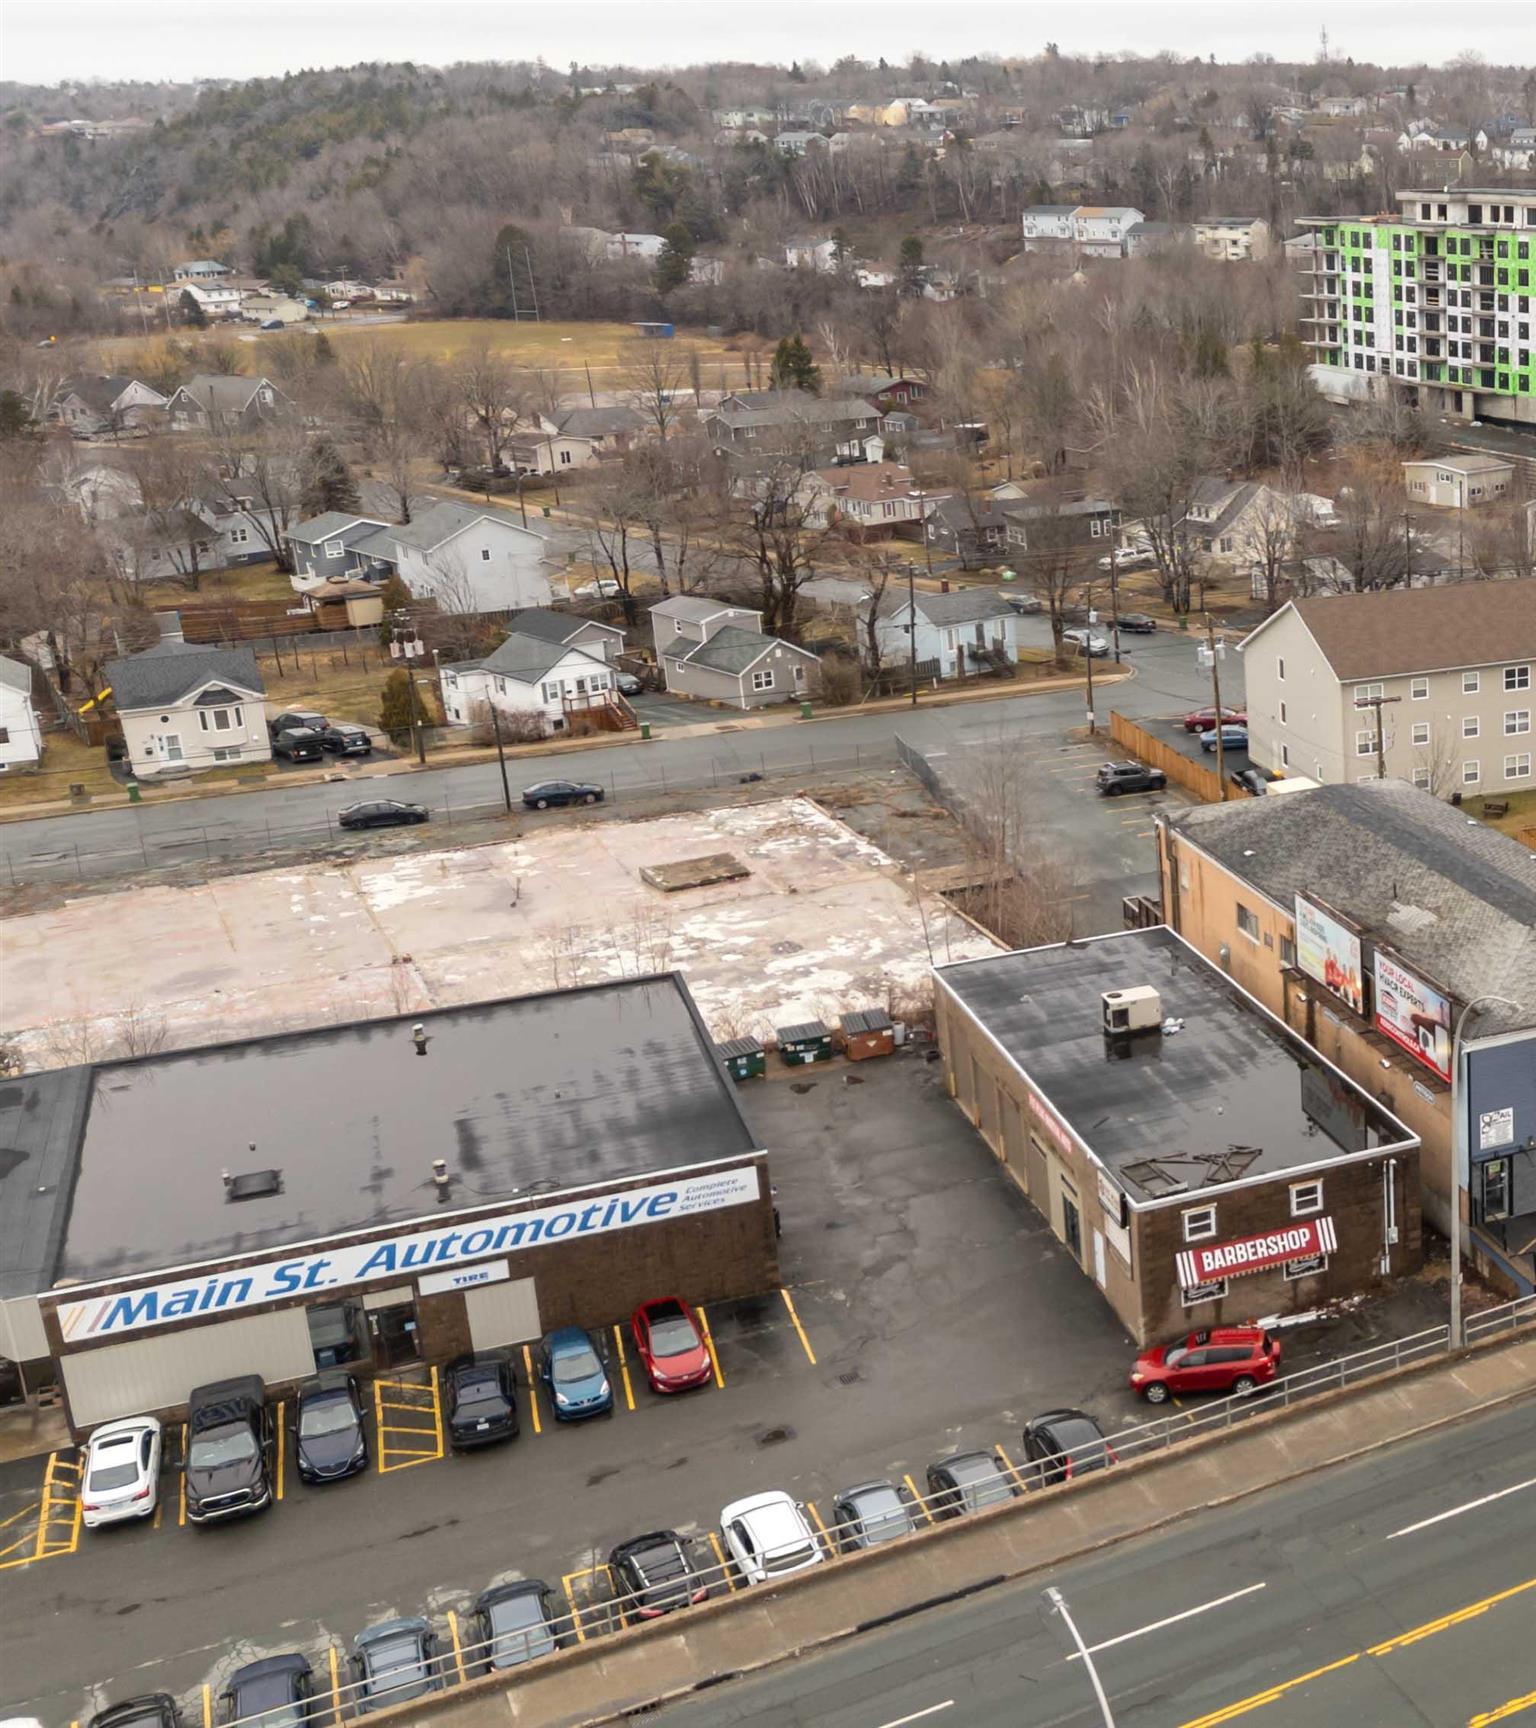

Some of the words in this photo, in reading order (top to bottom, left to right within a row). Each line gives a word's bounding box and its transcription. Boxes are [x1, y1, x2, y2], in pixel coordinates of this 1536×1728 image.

[682, 1184, 748, 1202] Automotive
[685, 1178, 739, 1194] Complete
[678, 1197, 726, 1211] Services
[1201, 1227, 1312, 1272] BARBERSHOP
[101, 1276, 254, 1330] Main
[265, 1258, 337, 1297] St.
[355, 1190, 679, 1277] Automotive
[452, 1271, 489, 1284] TIRE
